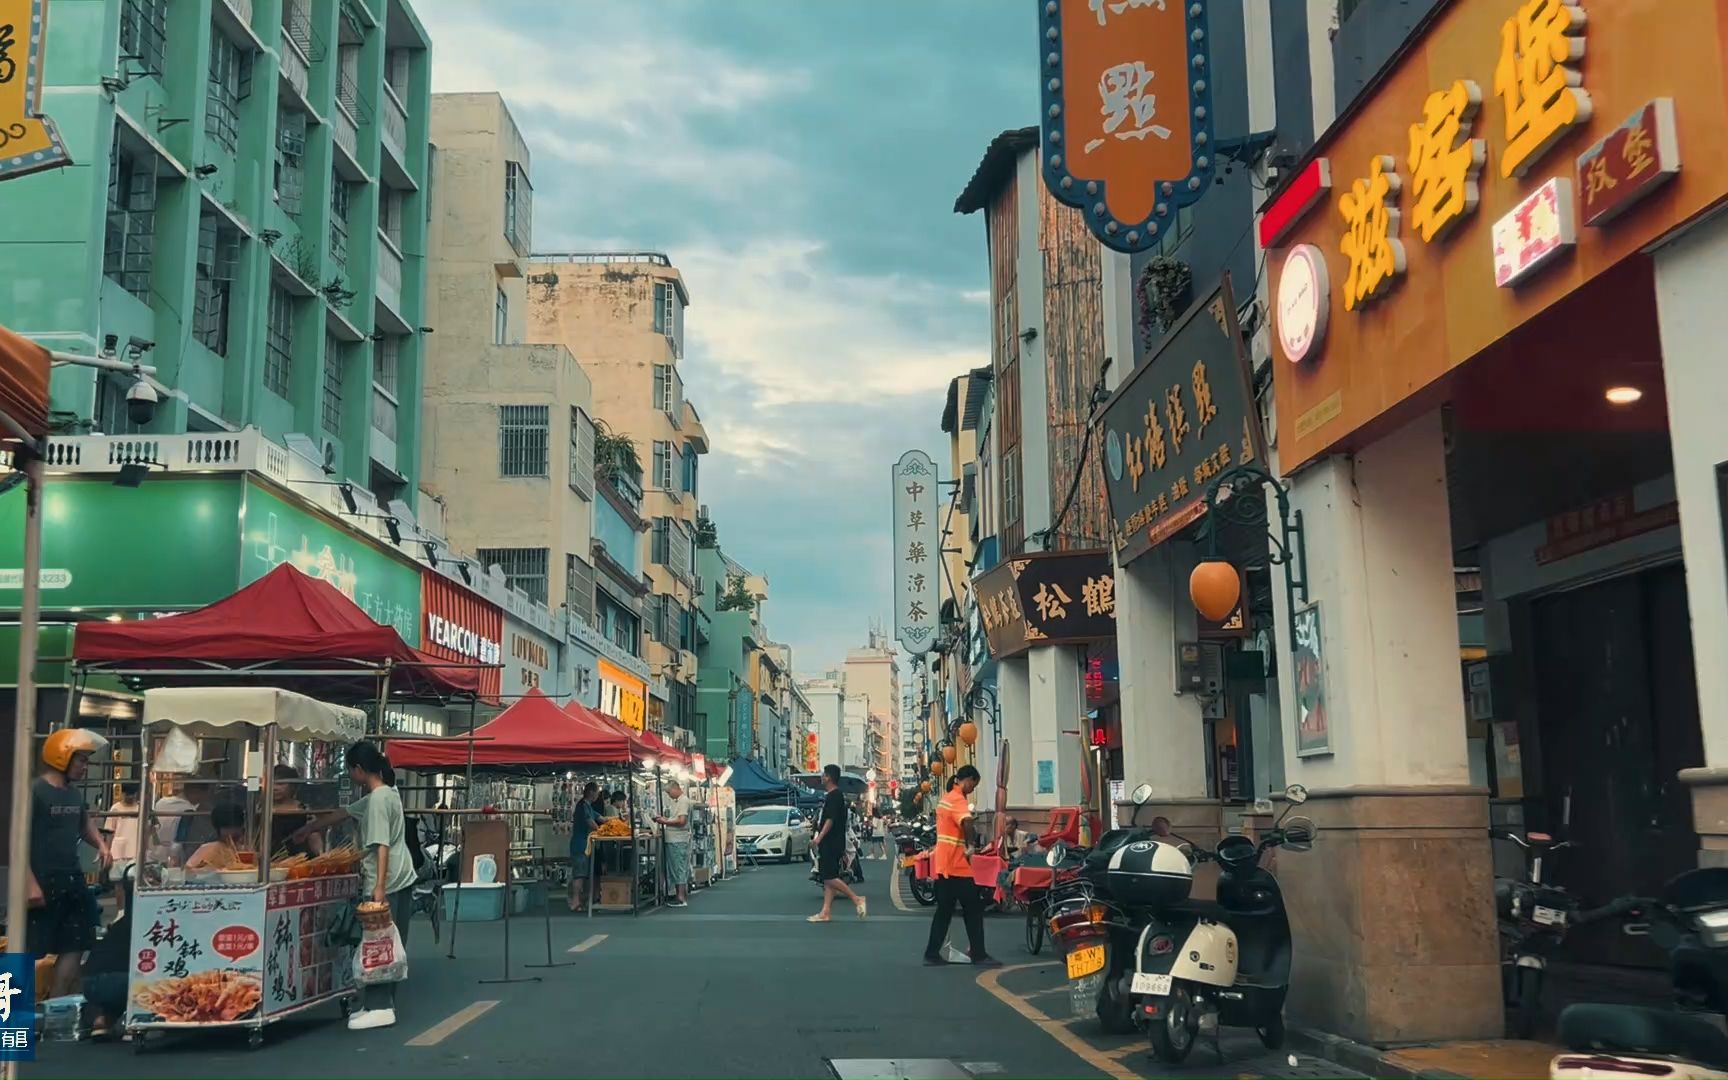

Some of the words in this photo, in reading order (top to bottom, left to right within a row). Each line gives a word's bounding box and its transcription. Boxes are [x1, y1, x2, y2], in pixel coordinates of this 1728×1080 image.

[905, 481, 928, 622] 中草藥涼茶
[428, 611, 479, 658] YEARCON
